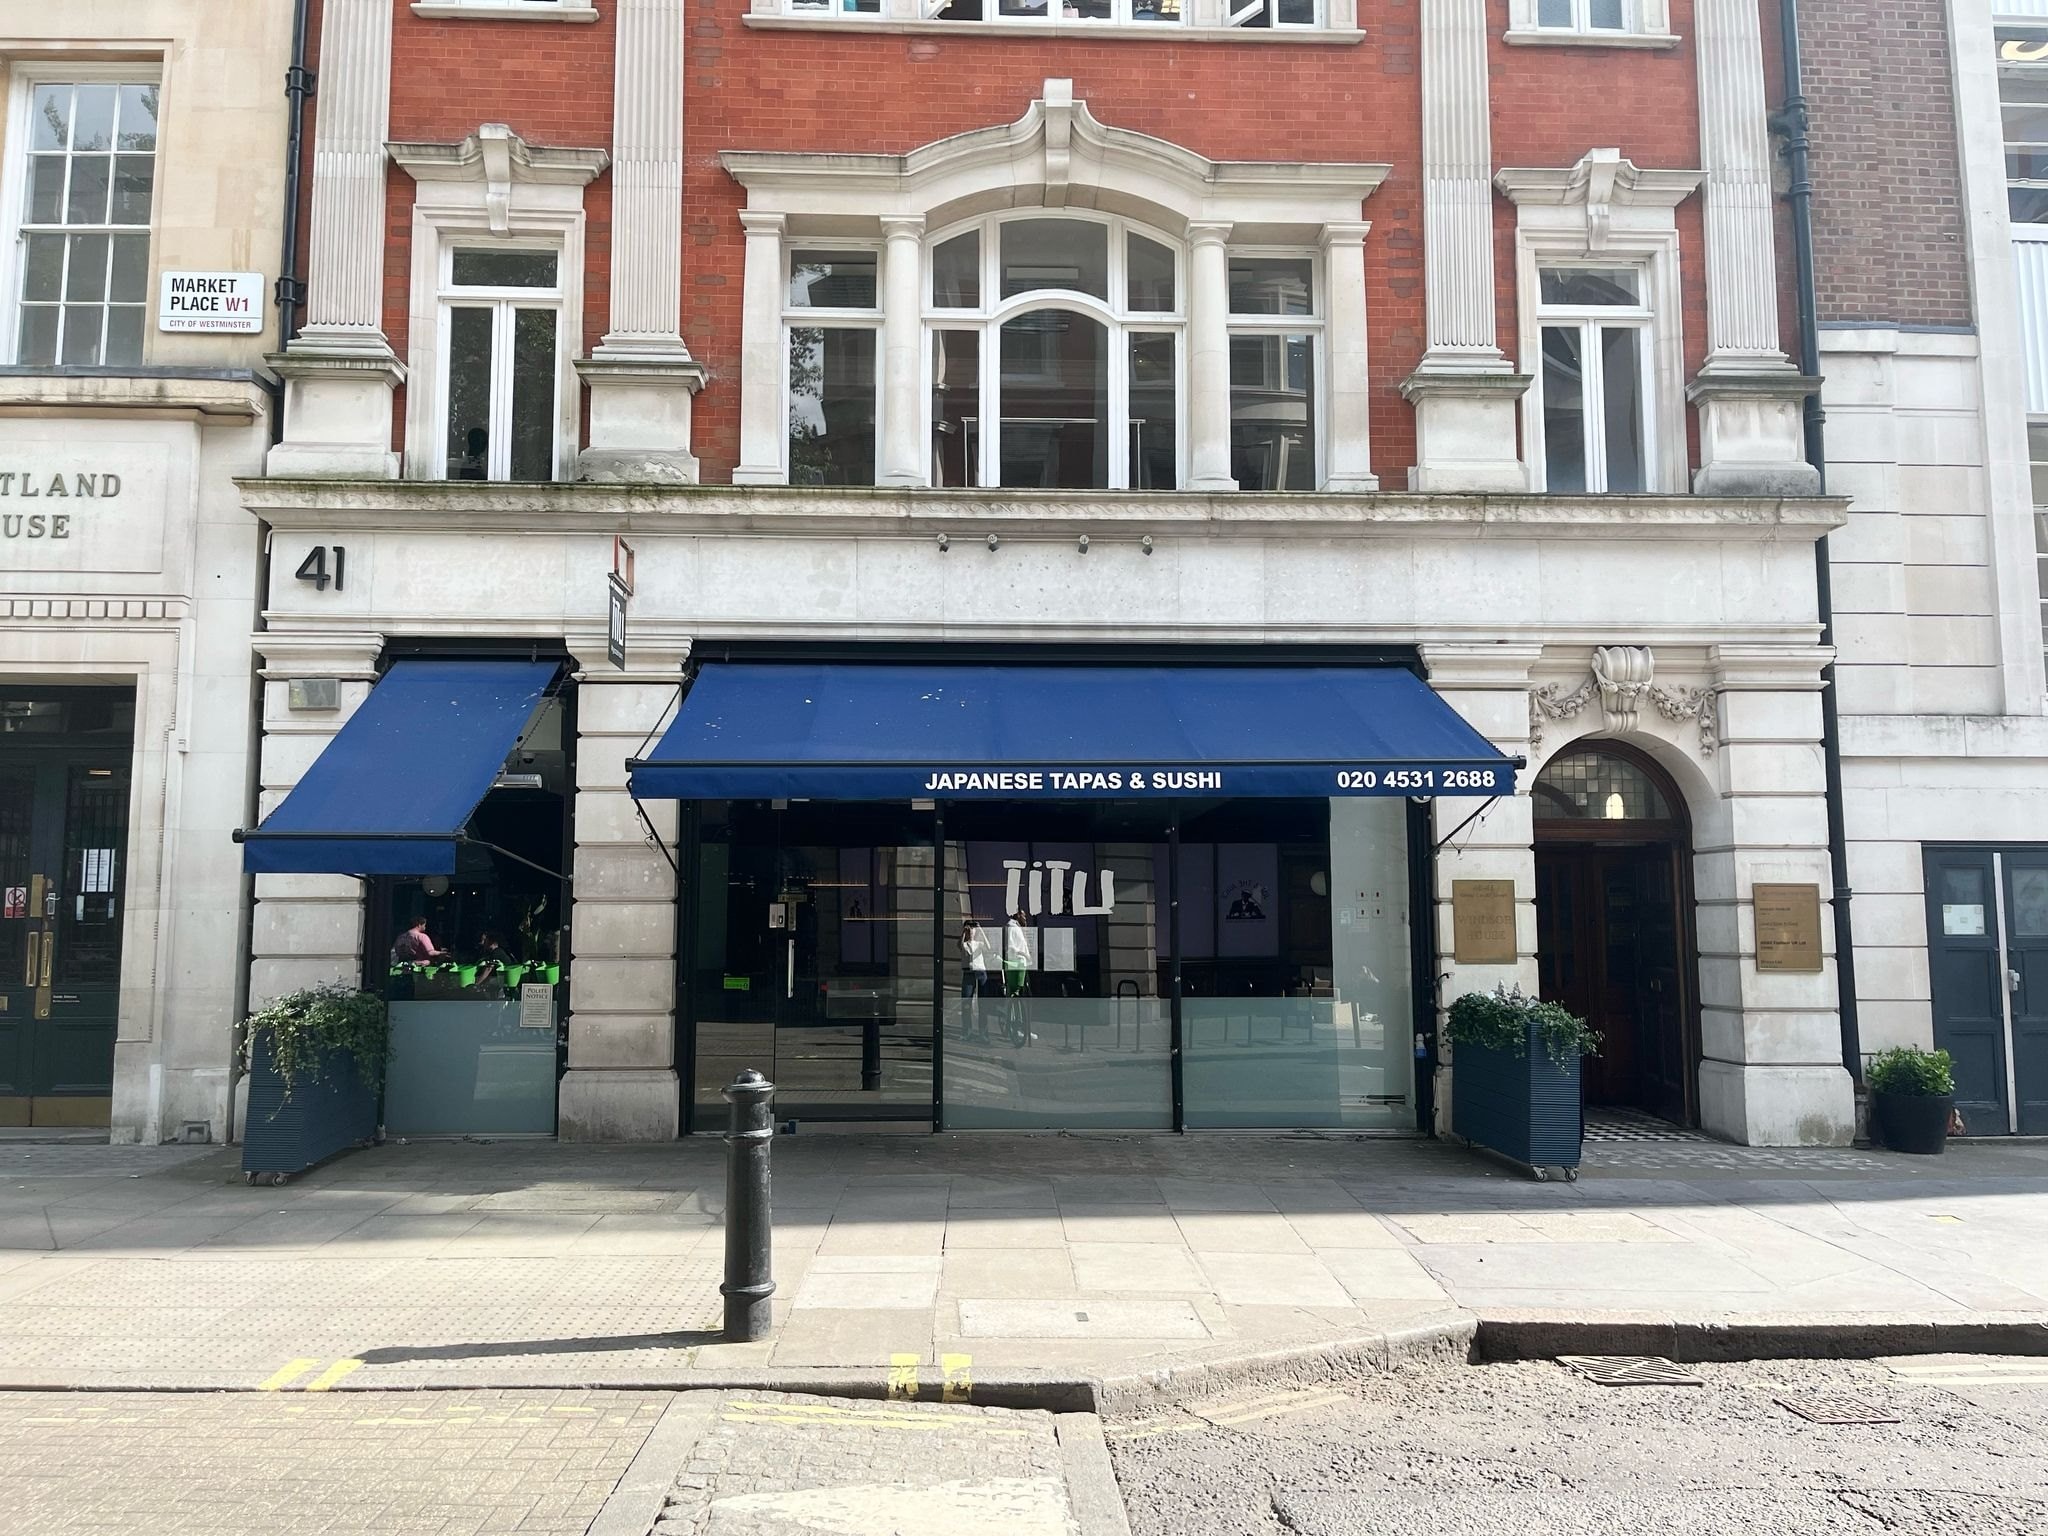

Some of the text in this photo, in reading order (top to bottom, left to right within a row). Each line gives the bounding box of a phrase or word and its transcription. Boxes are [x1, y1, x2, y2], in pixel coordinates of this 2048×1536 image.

[171, 277, 238, 293] MARKET
[170, 296, 249, 312] PLACE W1
[169, 319, 252, 329] CITY OF WESTMINSTER
[0, 472, 122, 498] TLAND
[2, 514, 71, 539] USE
[295, 545, 346, 592] 41
[925, 771, 1222, 790] JAPANESE TAPAS & SUSHI
[1336, 770, 1496, 788] 020 4531 2688
